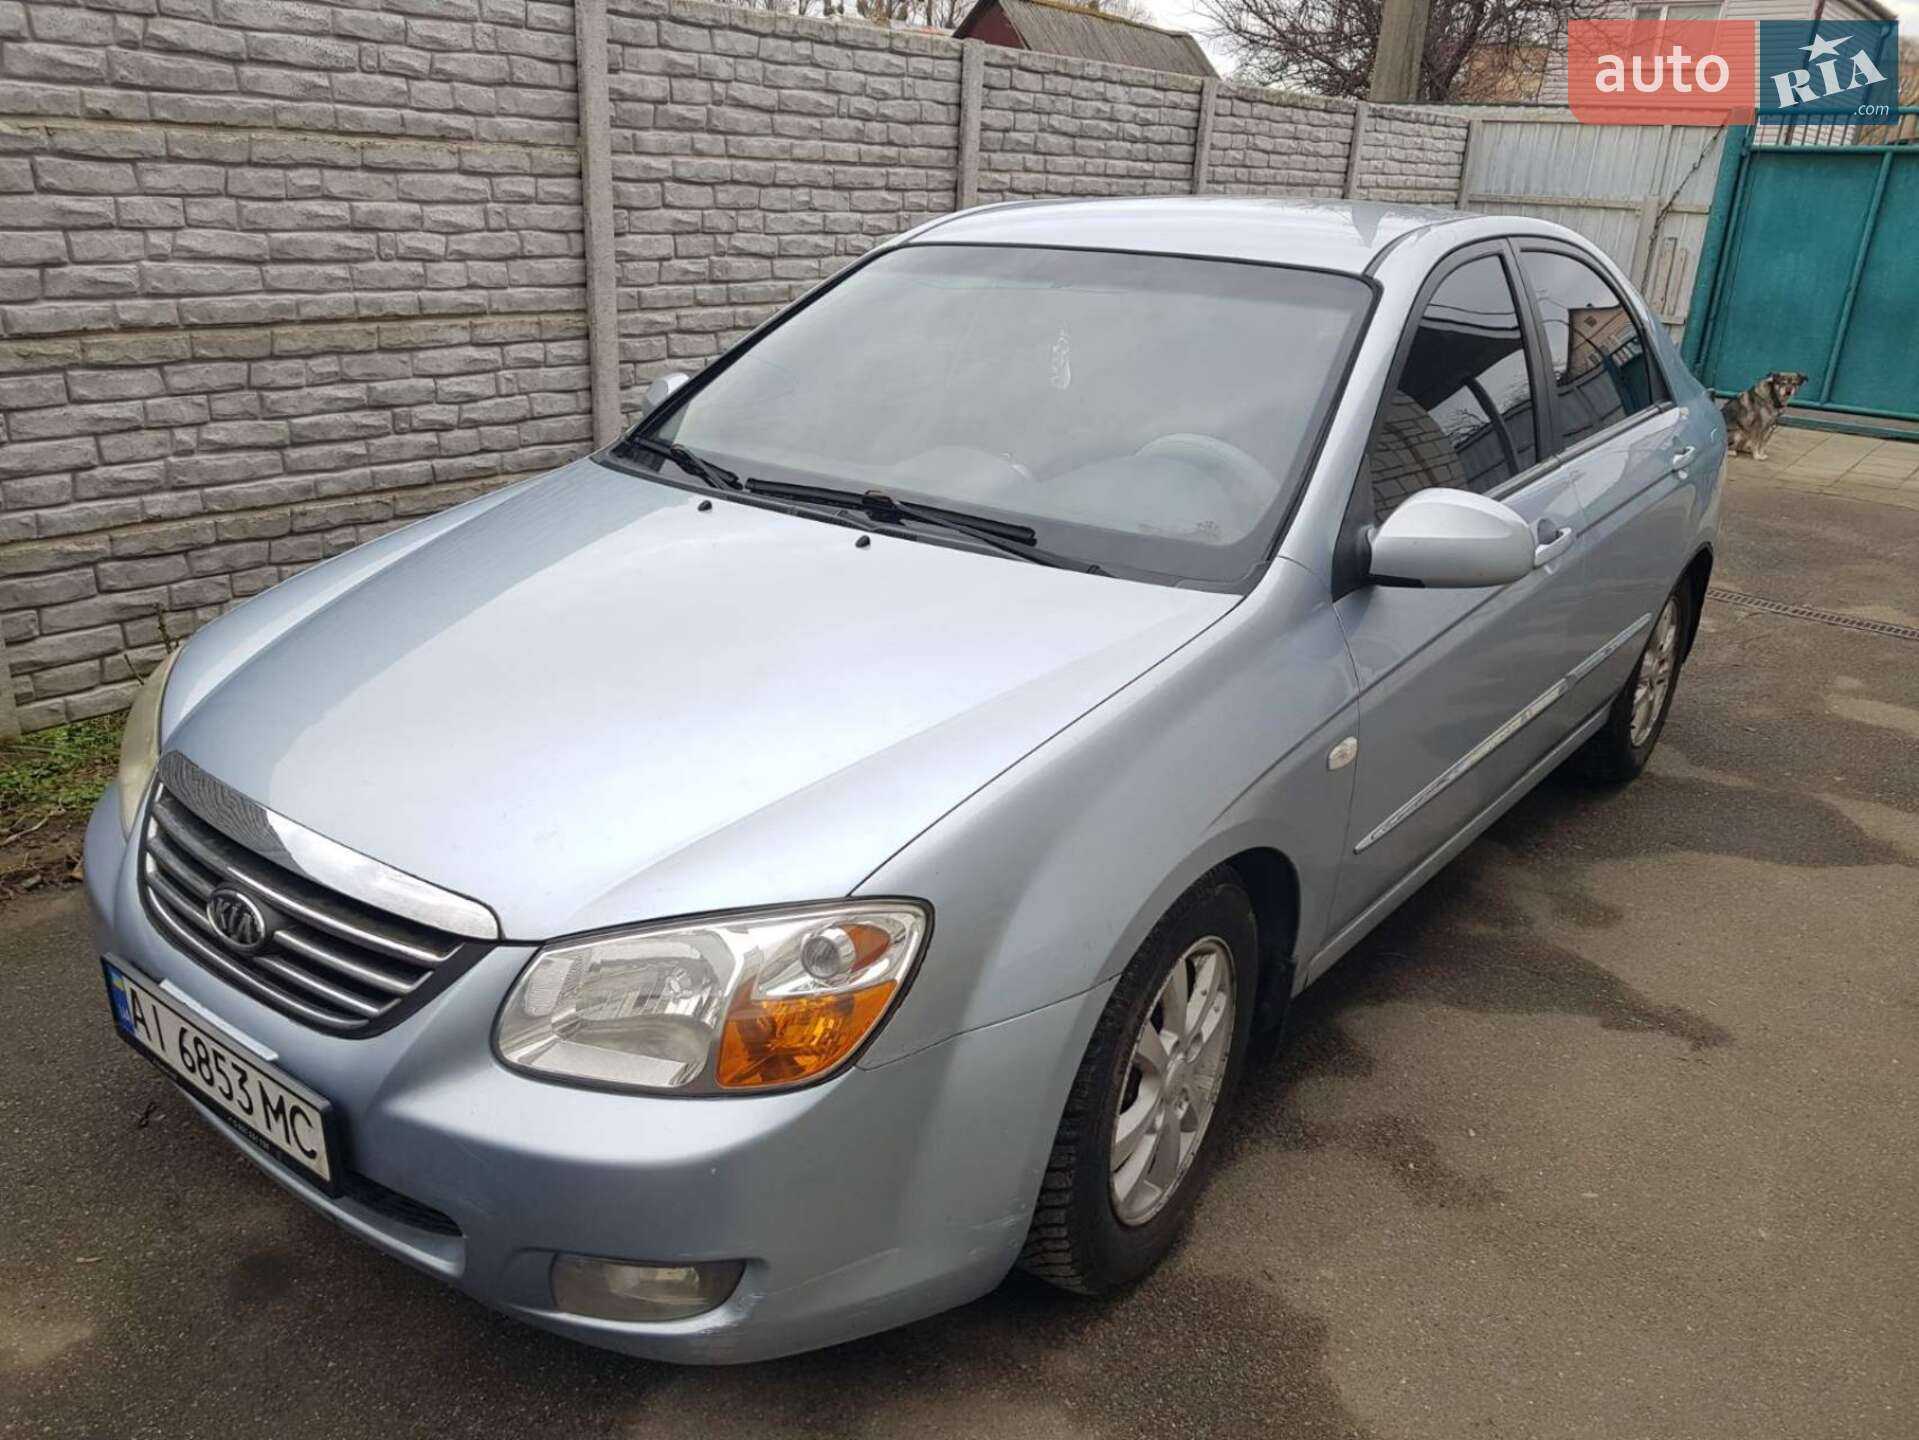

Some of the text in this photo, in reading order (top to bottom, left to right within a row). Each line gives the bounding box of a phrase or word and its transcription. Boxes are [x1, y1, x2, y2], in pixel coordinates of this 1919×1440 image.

[212, 896, 258, 945] KIA
[130, 987, 166, 1052] AI
[178, 1026, 254, 1116] 6853
[258, 1079, 317, 1159] MC
